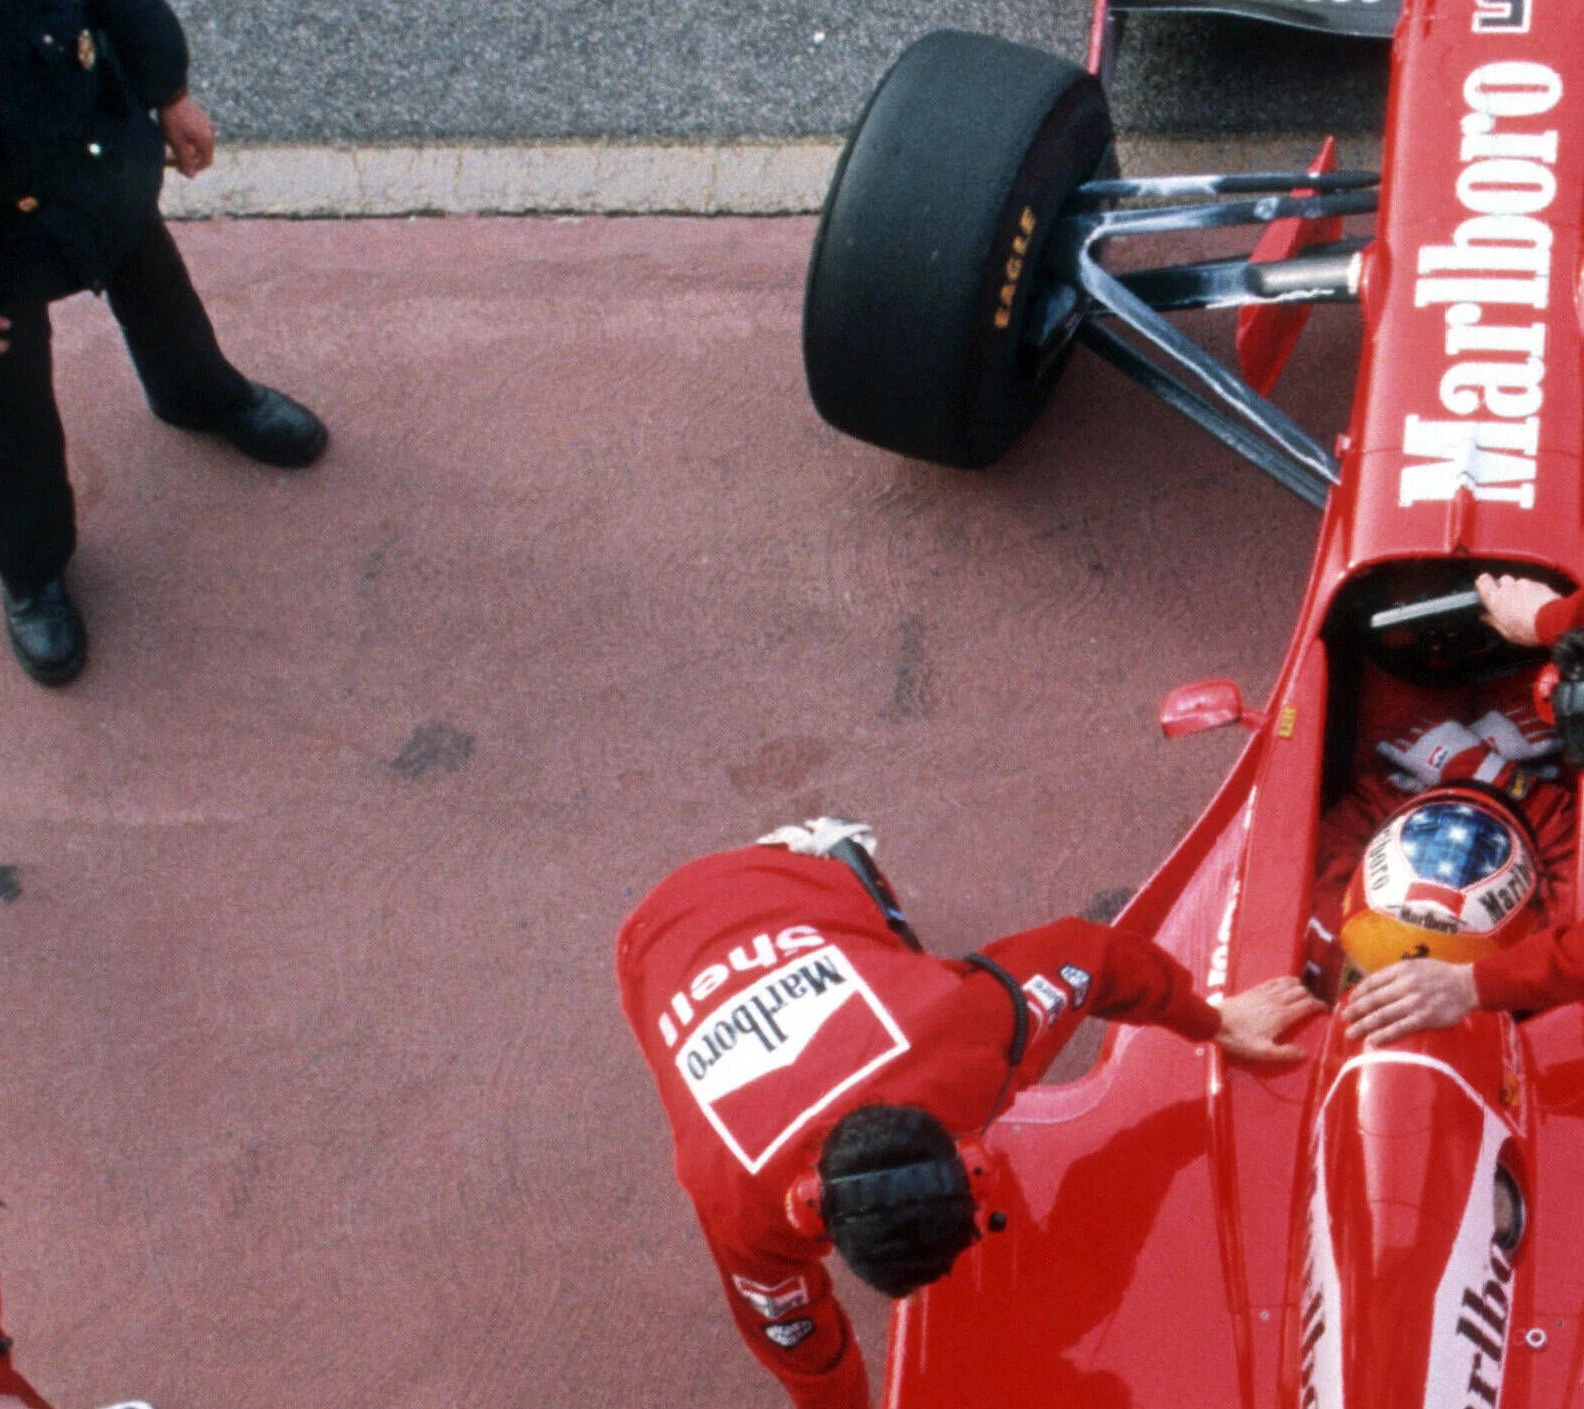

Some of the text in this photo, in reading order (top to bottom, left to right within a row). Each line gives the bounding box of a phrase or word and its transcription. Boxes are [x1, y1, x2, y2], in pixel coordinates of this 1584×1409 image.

[1399, 60, 1564, 509] Marlboro
[660, 924, 826, 1046] Shell
[687, 953, 843, 1082] Marlboro
